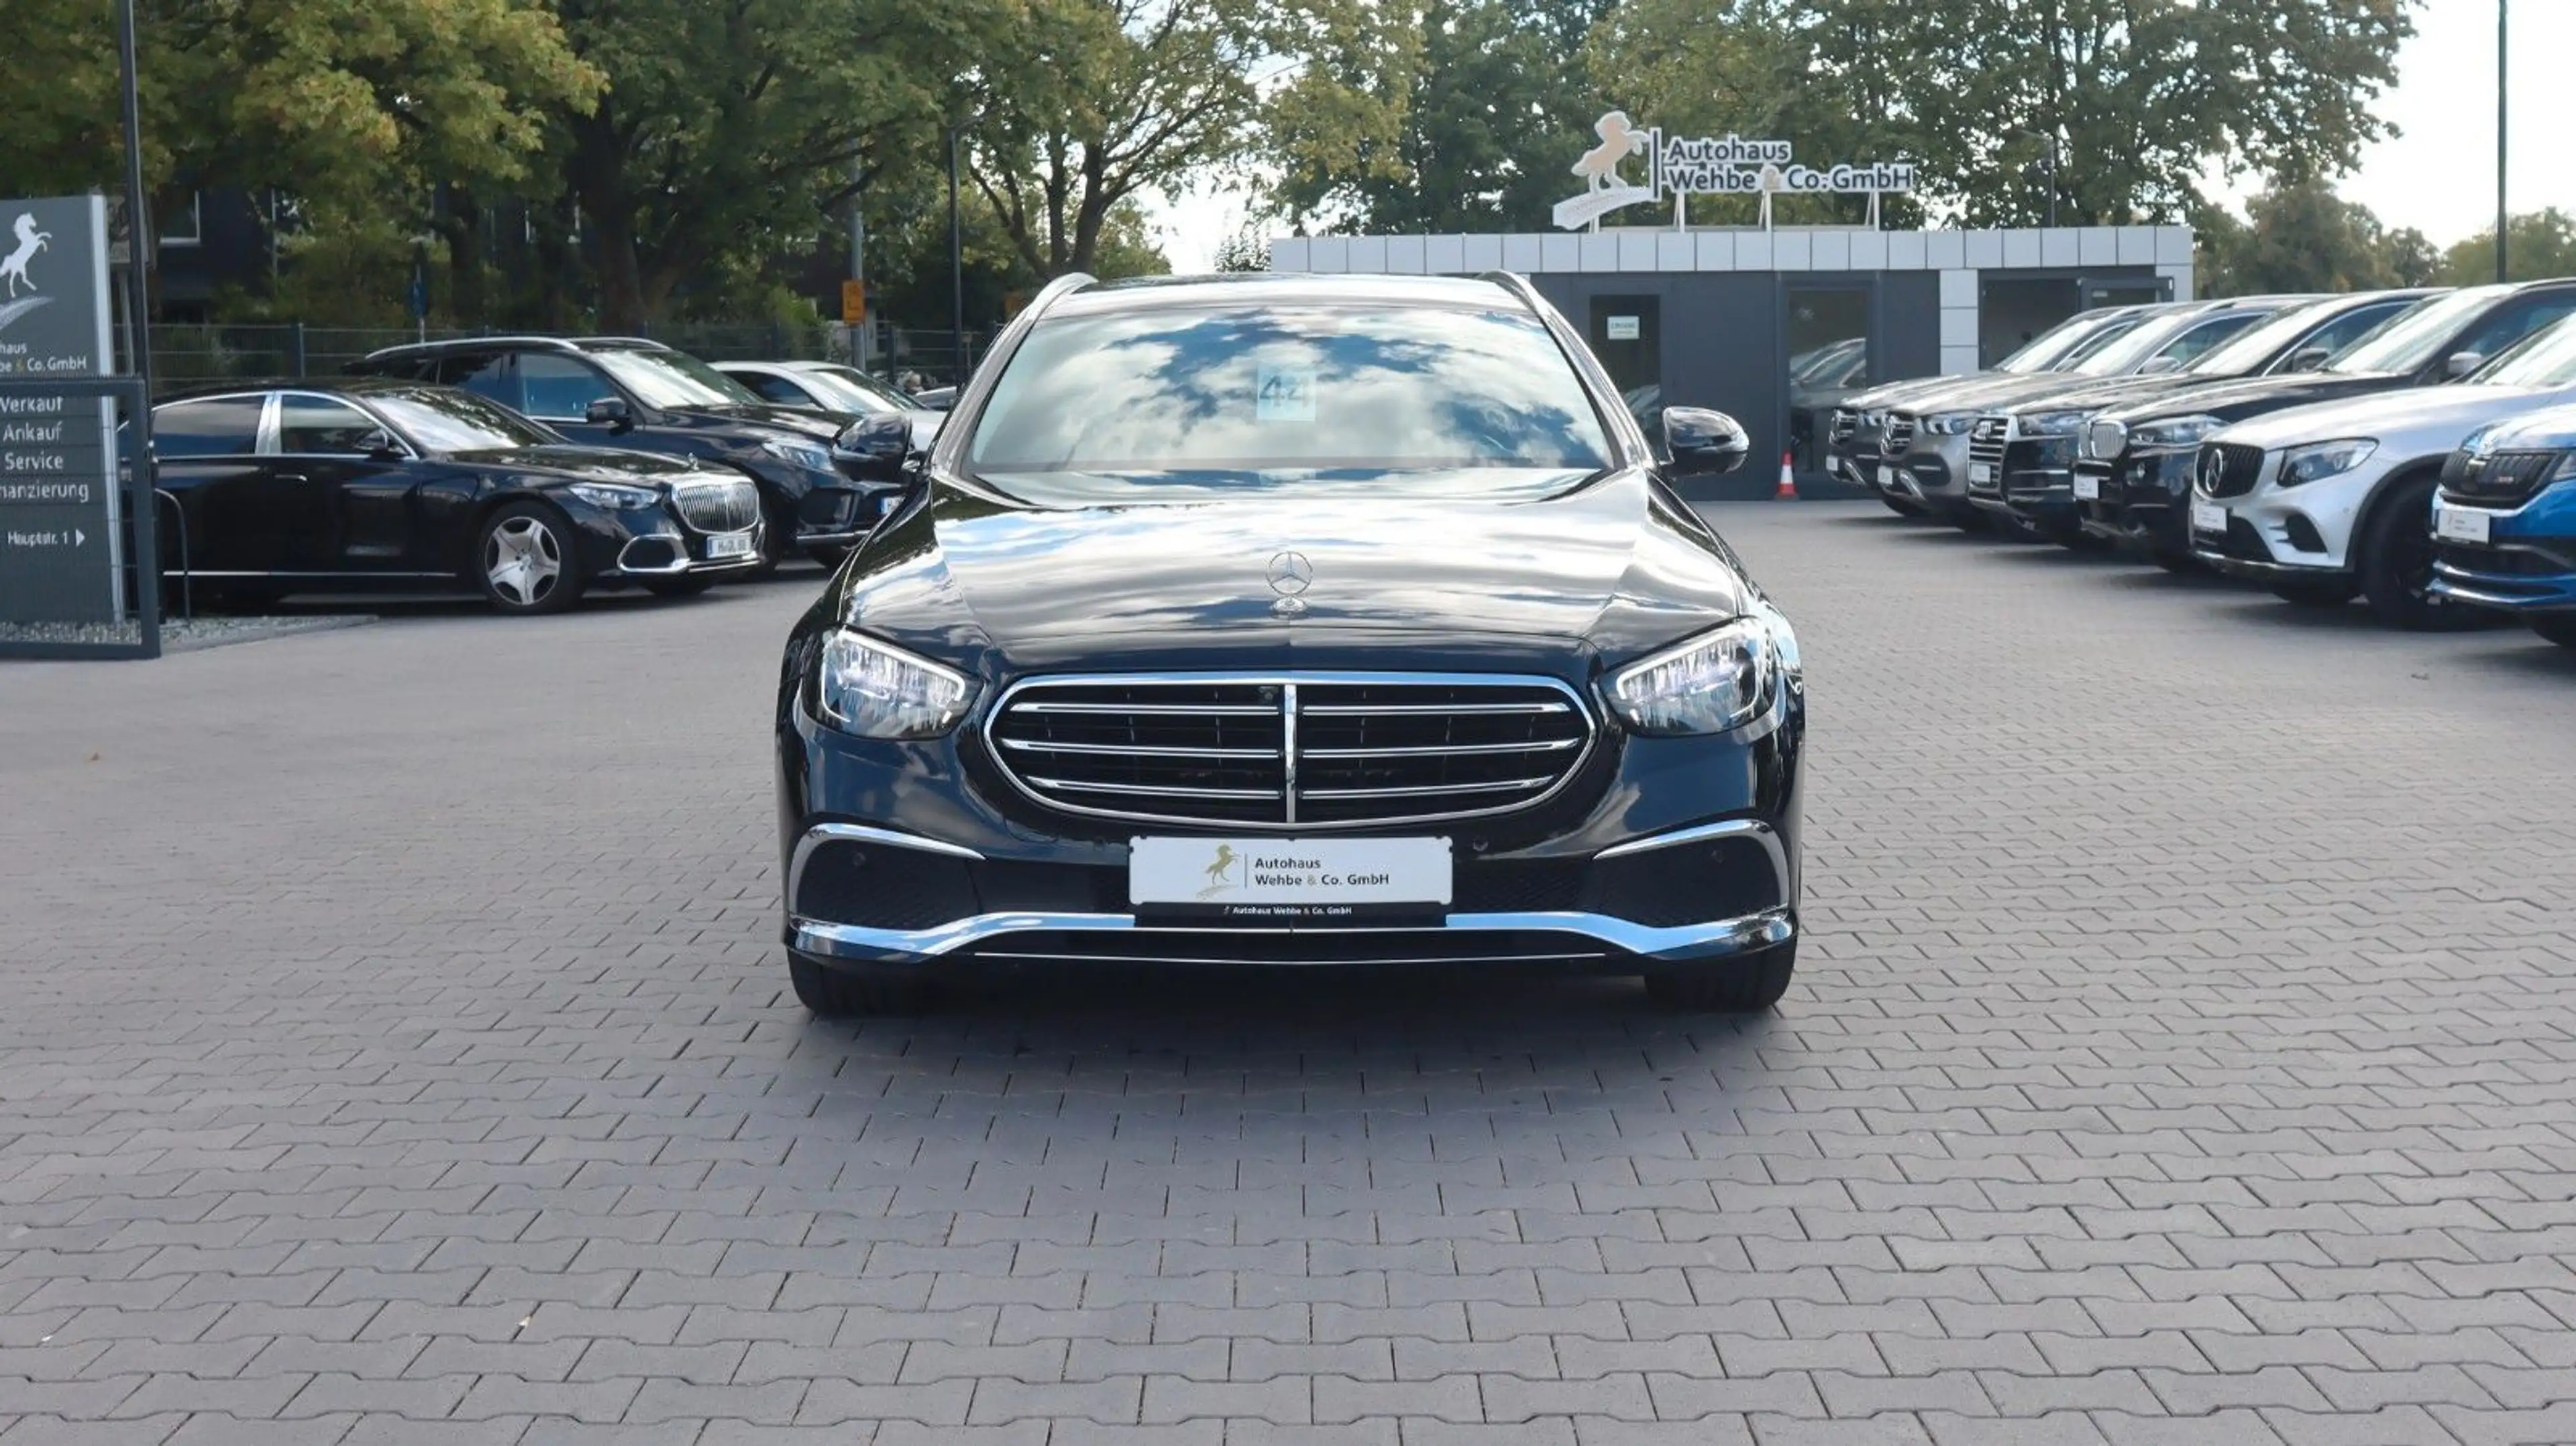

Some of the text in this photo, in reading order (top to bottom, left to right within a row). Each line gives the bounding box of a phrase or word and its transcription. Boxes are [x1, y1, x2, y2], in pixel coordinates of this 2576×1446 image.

[1668, 138, 1789, 160] Autohaus
[1668, 167, 1756, 190] Wehbe
[1763, 168, 1780, 191] &
[1833, 166, 1911, 189] GmbH
[47, 355, 87, 370] GmbH
[0, 396, 64, 413] Verkauf
[3, 421, 62, 442] Ankauf
[5, 450, 64, 470] Service
[62, 530, 68, 545] 1
[1255, 858, 1321, 869] Autohaus
[1255, 874, 1389, 886] Wehbe & Co. GmbH
[1232, 907, 1271, 915] Autohaus
[1274, 907, 1301, 915] Wehbe
[1326, 907, 1352, 915] GmbH
